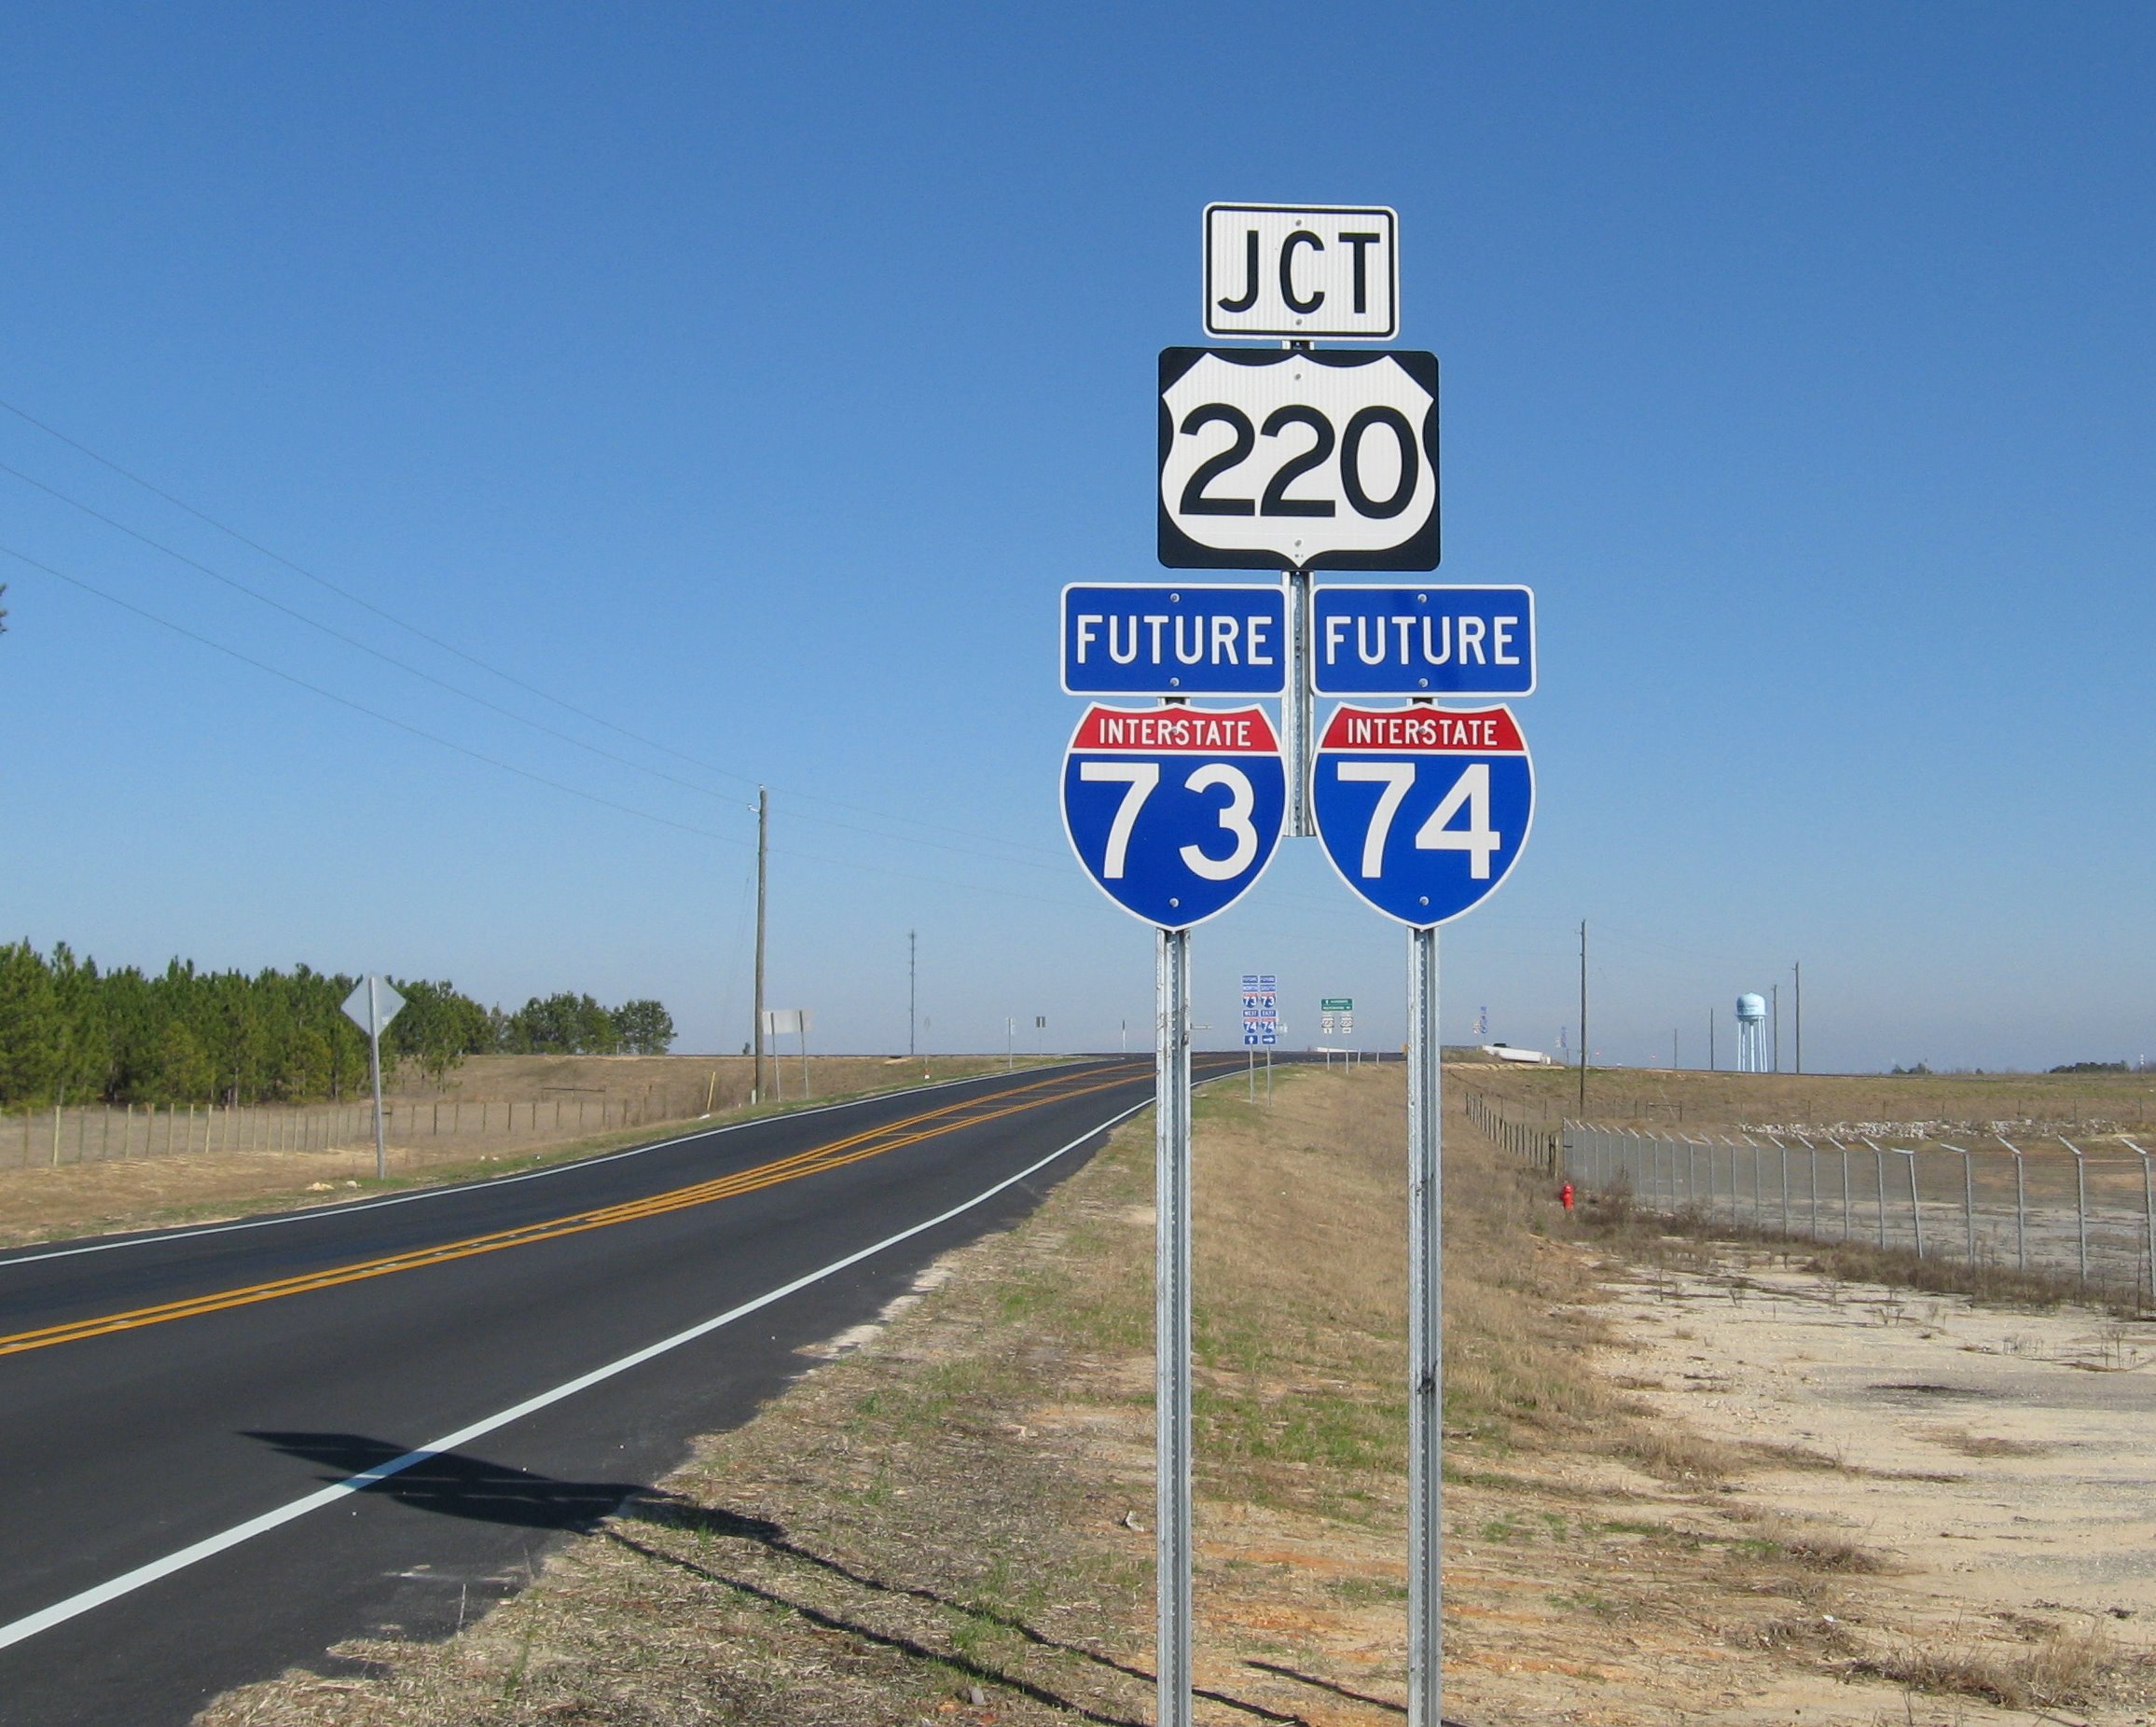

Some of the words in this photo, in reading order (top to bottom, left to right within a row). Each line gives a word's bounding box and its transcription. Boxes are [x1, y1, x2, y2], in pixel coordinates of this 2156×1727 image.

[1218, 230, 1380, 313] JCT
[1180, 403, 1418, 519] 220
[1077, 615, 1274, 665] FUTURE
[1326, 615, 1520, 665] FUTURE
[1099, 718, 1251, 746] INTERSTATE
[1348, 718, 1498, 746] INTERSTATE
[1080, 762, 1259, 880] 73
[1337, 762, 1500, 879] 74
[1244, 996, 1257, 1005] 73
[1262, 996, 1275, 1005] 73
[1244, 1021, 1257, 1030] 74
[1262, 1021, 1275, 1030] 74
